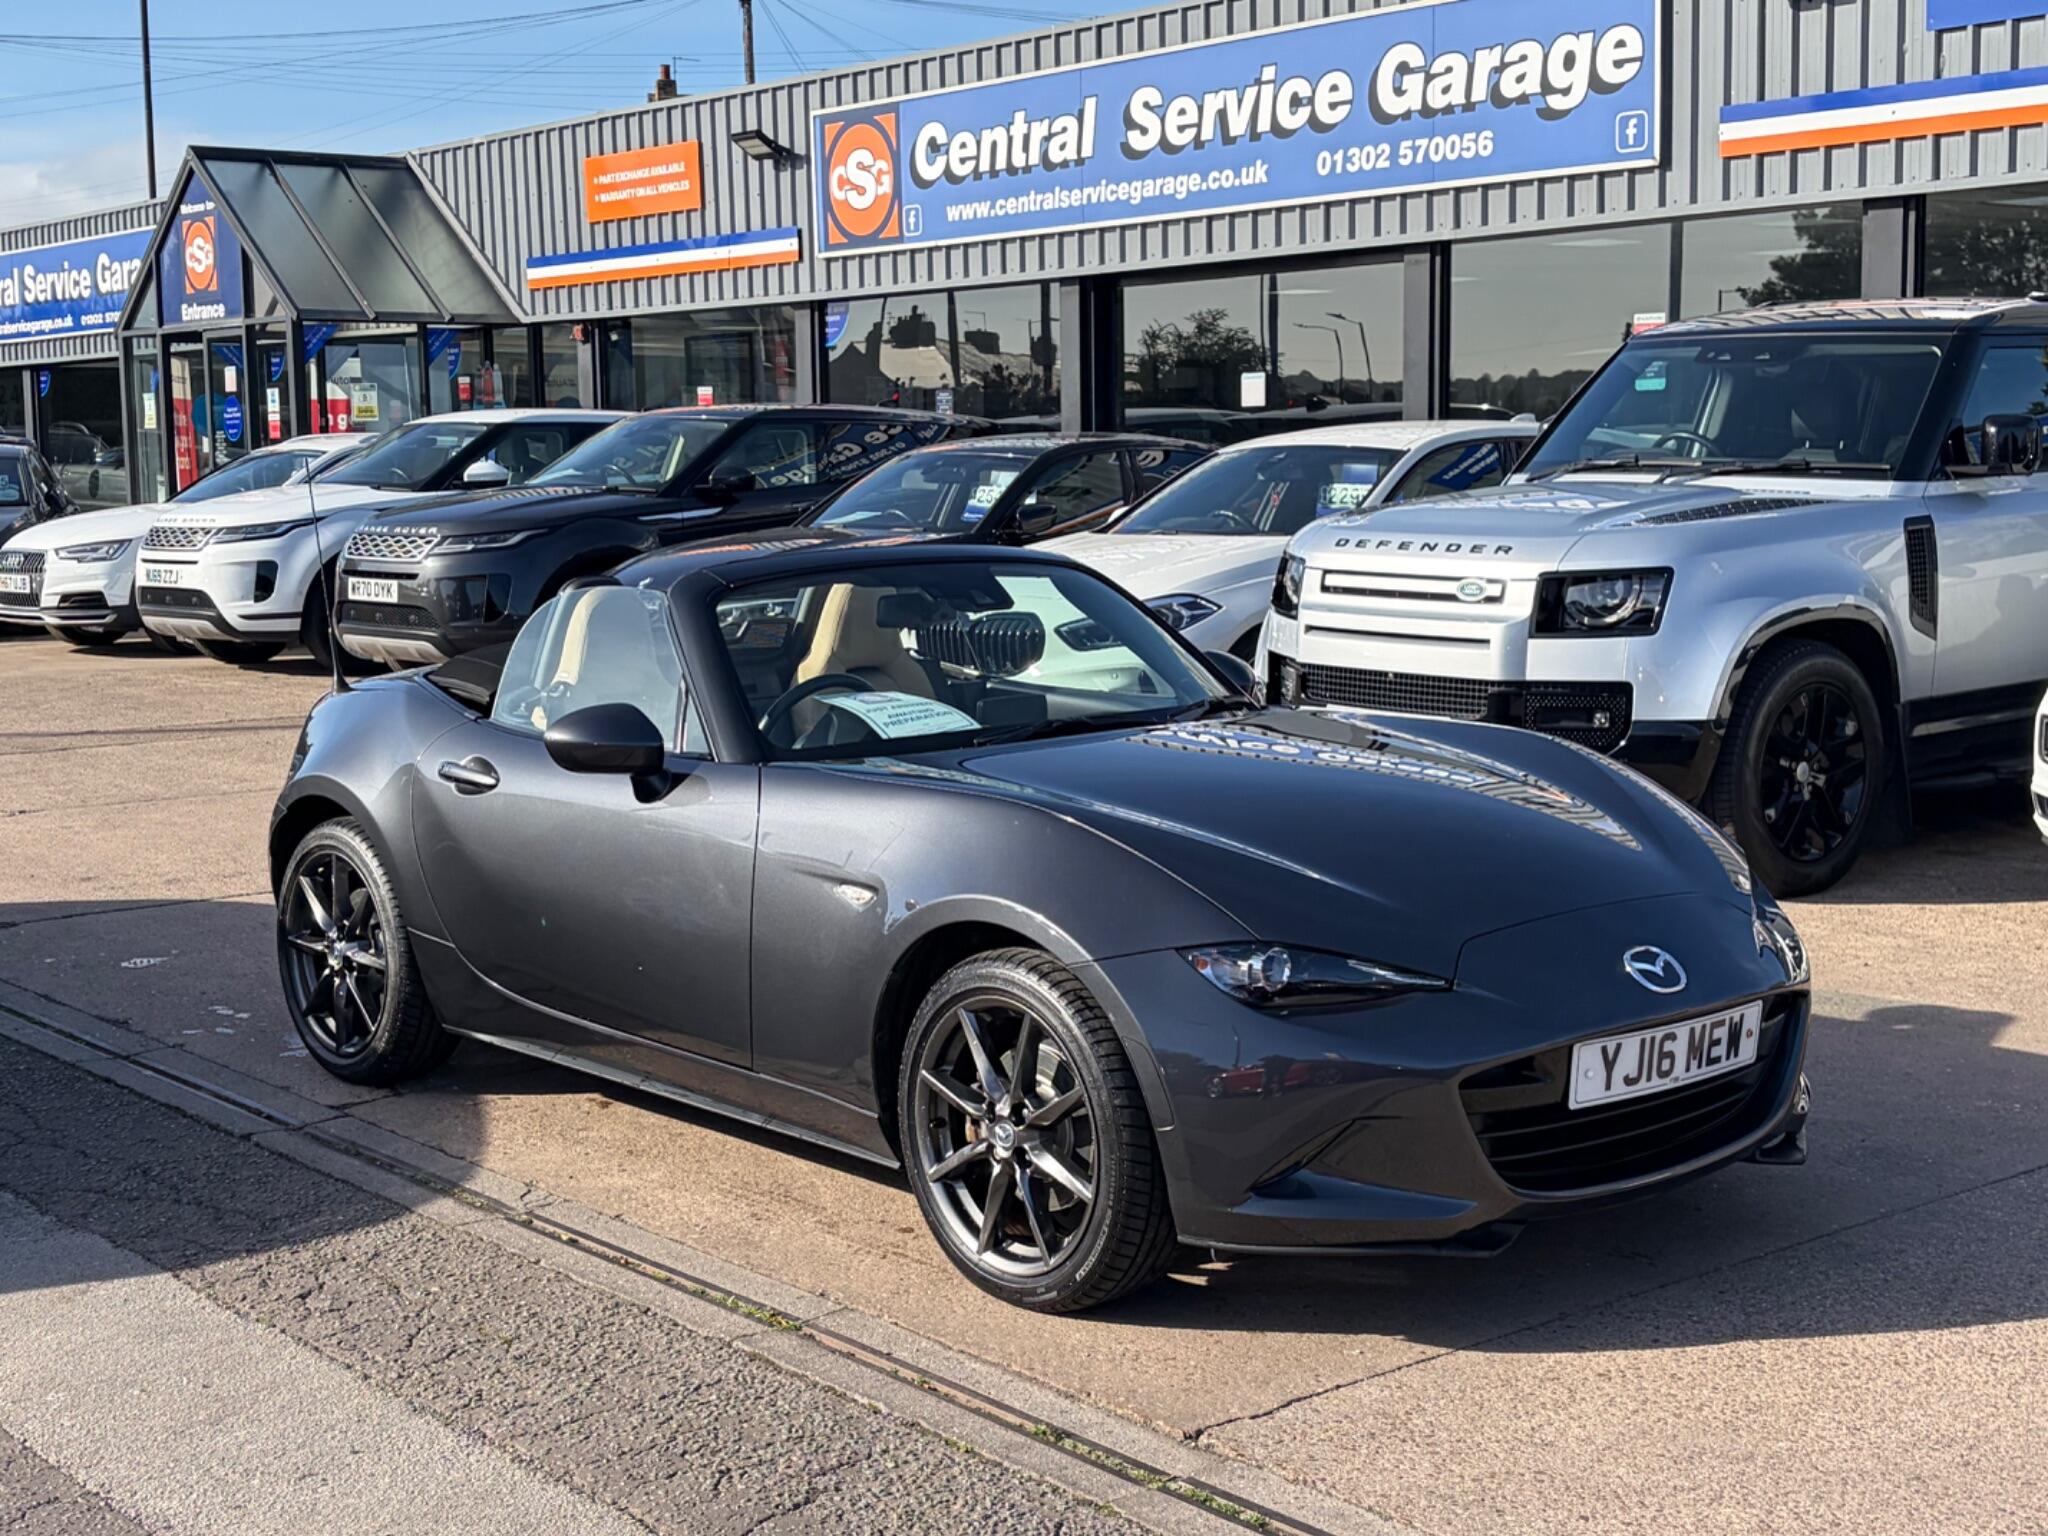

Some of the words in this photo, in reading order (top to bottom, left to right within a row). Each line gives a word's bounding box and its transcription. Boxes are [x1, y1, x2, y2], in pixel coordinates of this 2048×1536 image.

[913, 96, 1098, 185] Central
[1123, 64, 1353, 155] Service
[1374, 23, 1645, 117] Garage
[1316, 143, 1391, 177] 01302
[1398, 130, 1495, 167] 570056
[598, 173, 615, 185] PART
[615, 168, 650, 182] EXCHANGE
[651, 162, 685, 175] AVAILABLE
[830, 147, 892, 210] CSG
[600, 188, 635, 203] WARRANTY
[658, 179, 690, 193] VEHICLES
[946, 159, 1269, 222] www.centralservicegarage.co.uk
[23, 261, 91, 303] Service
[81, 313, 103, 326] 01302
[181, 303, 226, 321] Entrance
[393, 525, 438, 534] ROVER
[1333, 537, 1514, 556] DEFENDER
[882, 710, 953, 728] PREPARATION
[1600, 1031, 1678, 1093] YJ16
[1684, 1012, 1745, 1073] MEW
